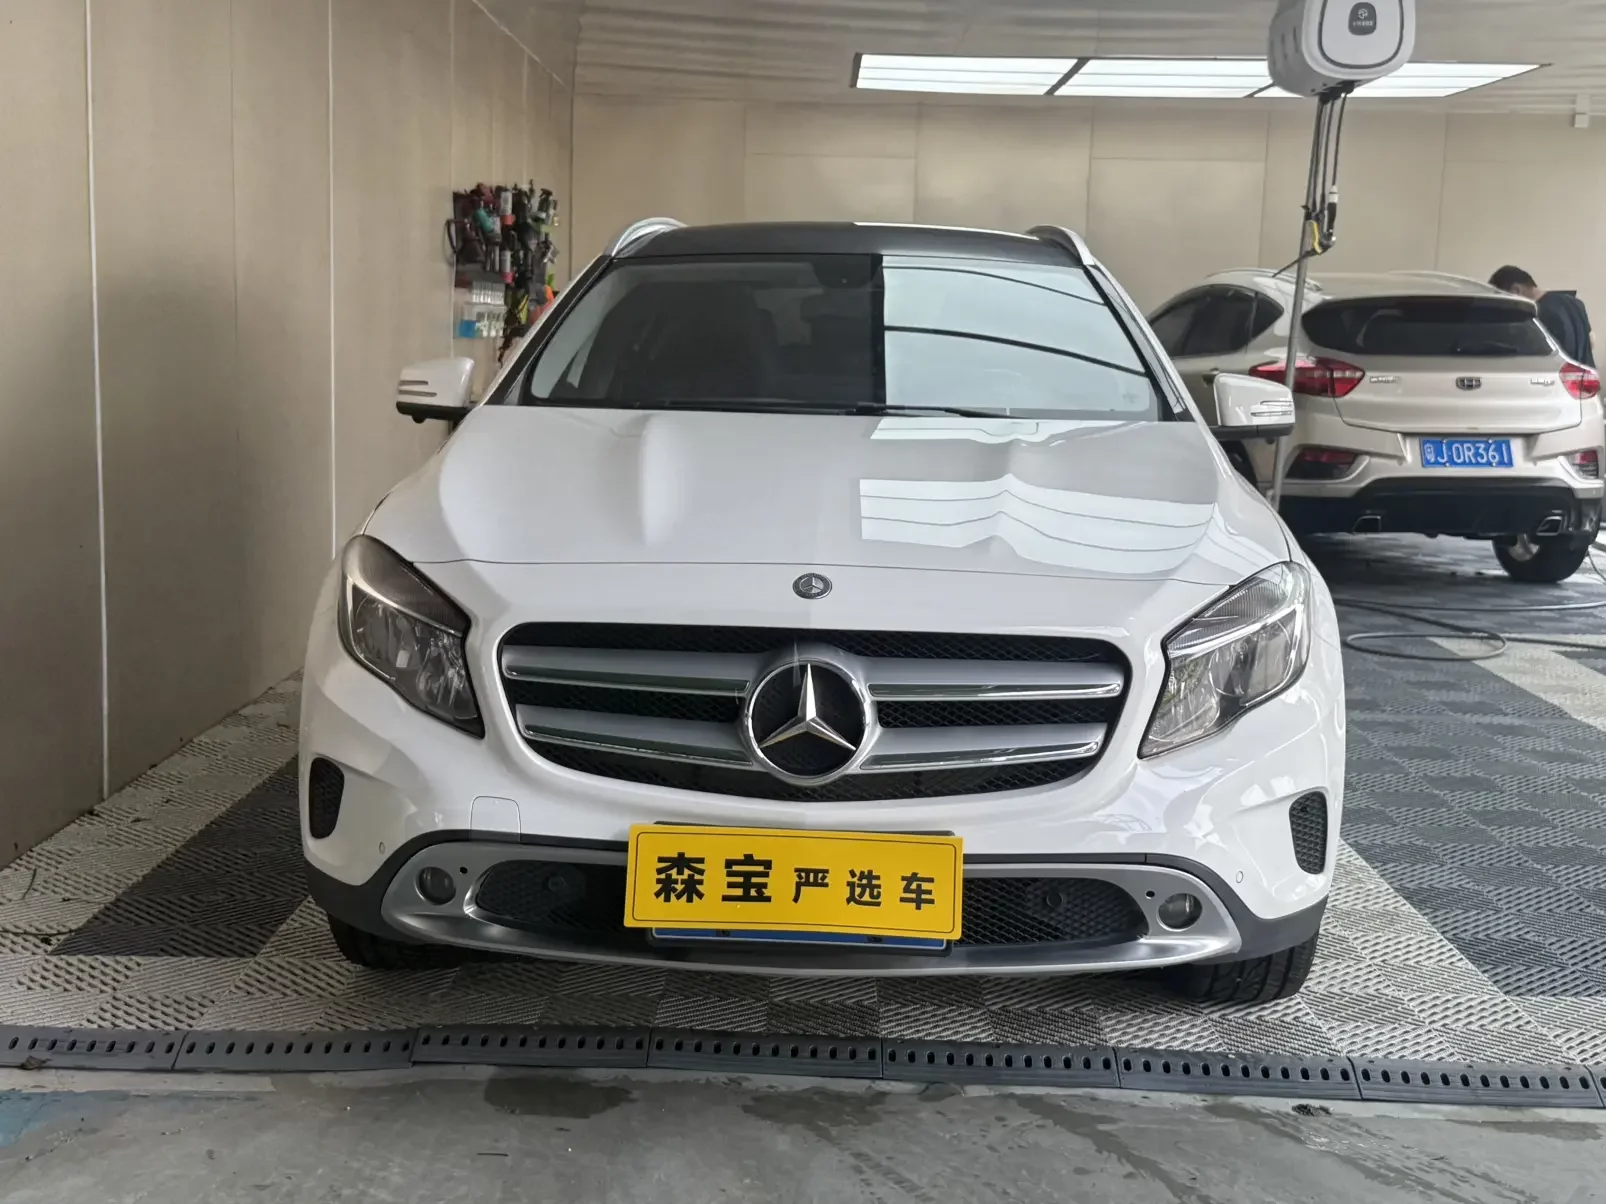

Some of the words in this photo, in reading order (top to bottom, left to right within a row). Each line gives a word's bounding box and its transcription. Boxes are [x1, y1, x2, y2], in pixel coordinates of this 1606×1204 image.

[653, 851, 936, 911] 森宝严选车
